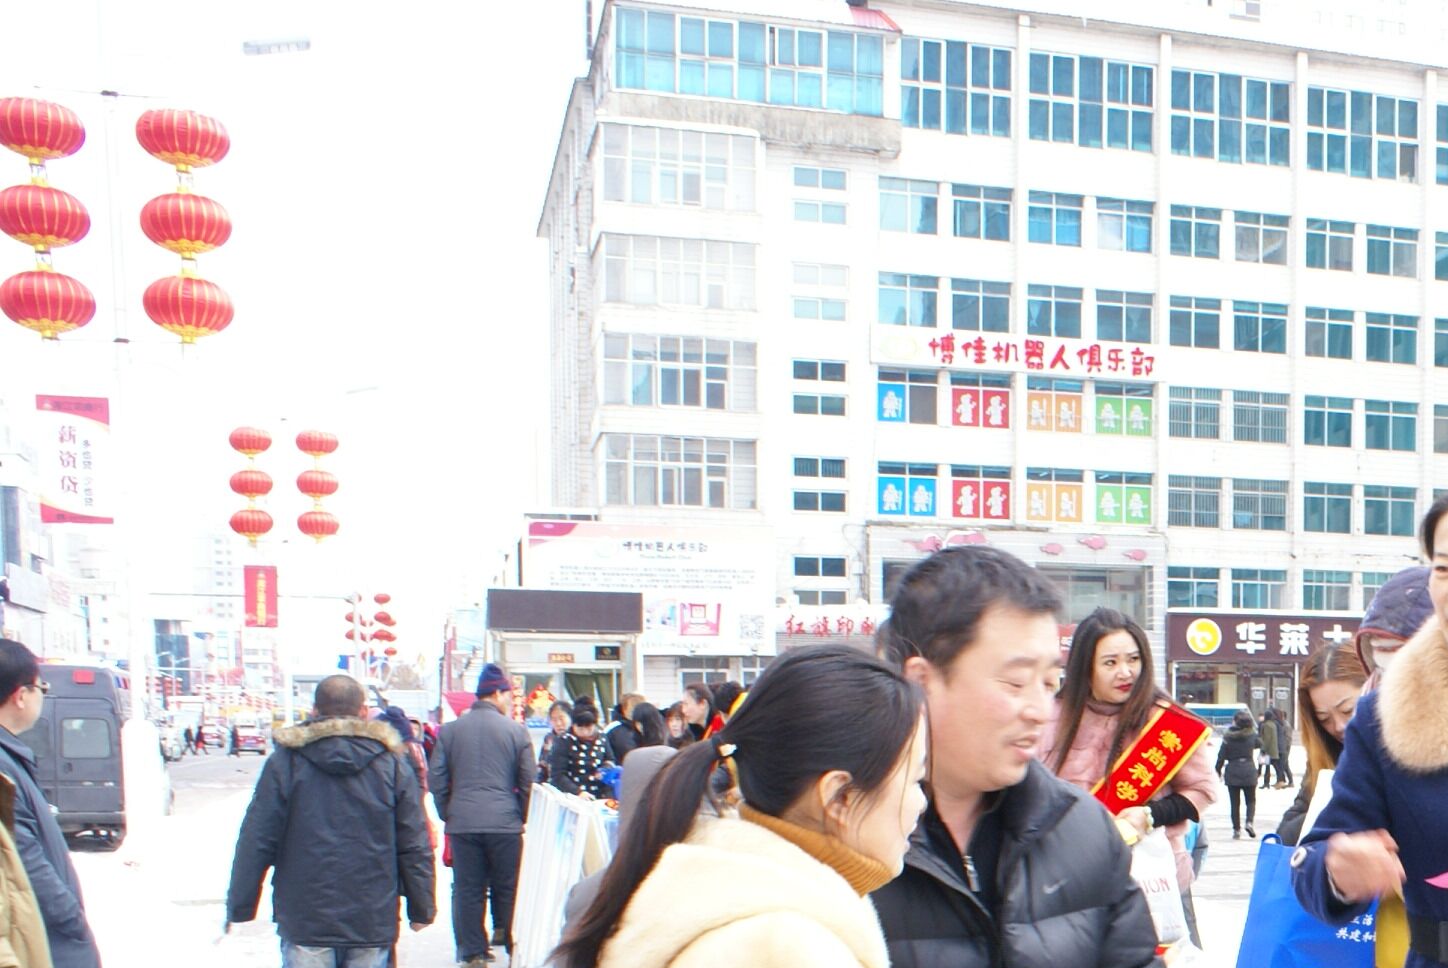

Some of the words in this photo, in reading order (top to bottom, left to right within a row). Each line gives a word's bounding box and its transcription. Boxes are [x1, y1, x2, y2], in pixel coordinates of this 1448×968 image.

[928, 333, 1155, 376] 博佳机器人俱乐部
[1115, 730, 1183, 802] 崇尚科学
[1335, 927, 1377, 943] 共建和
